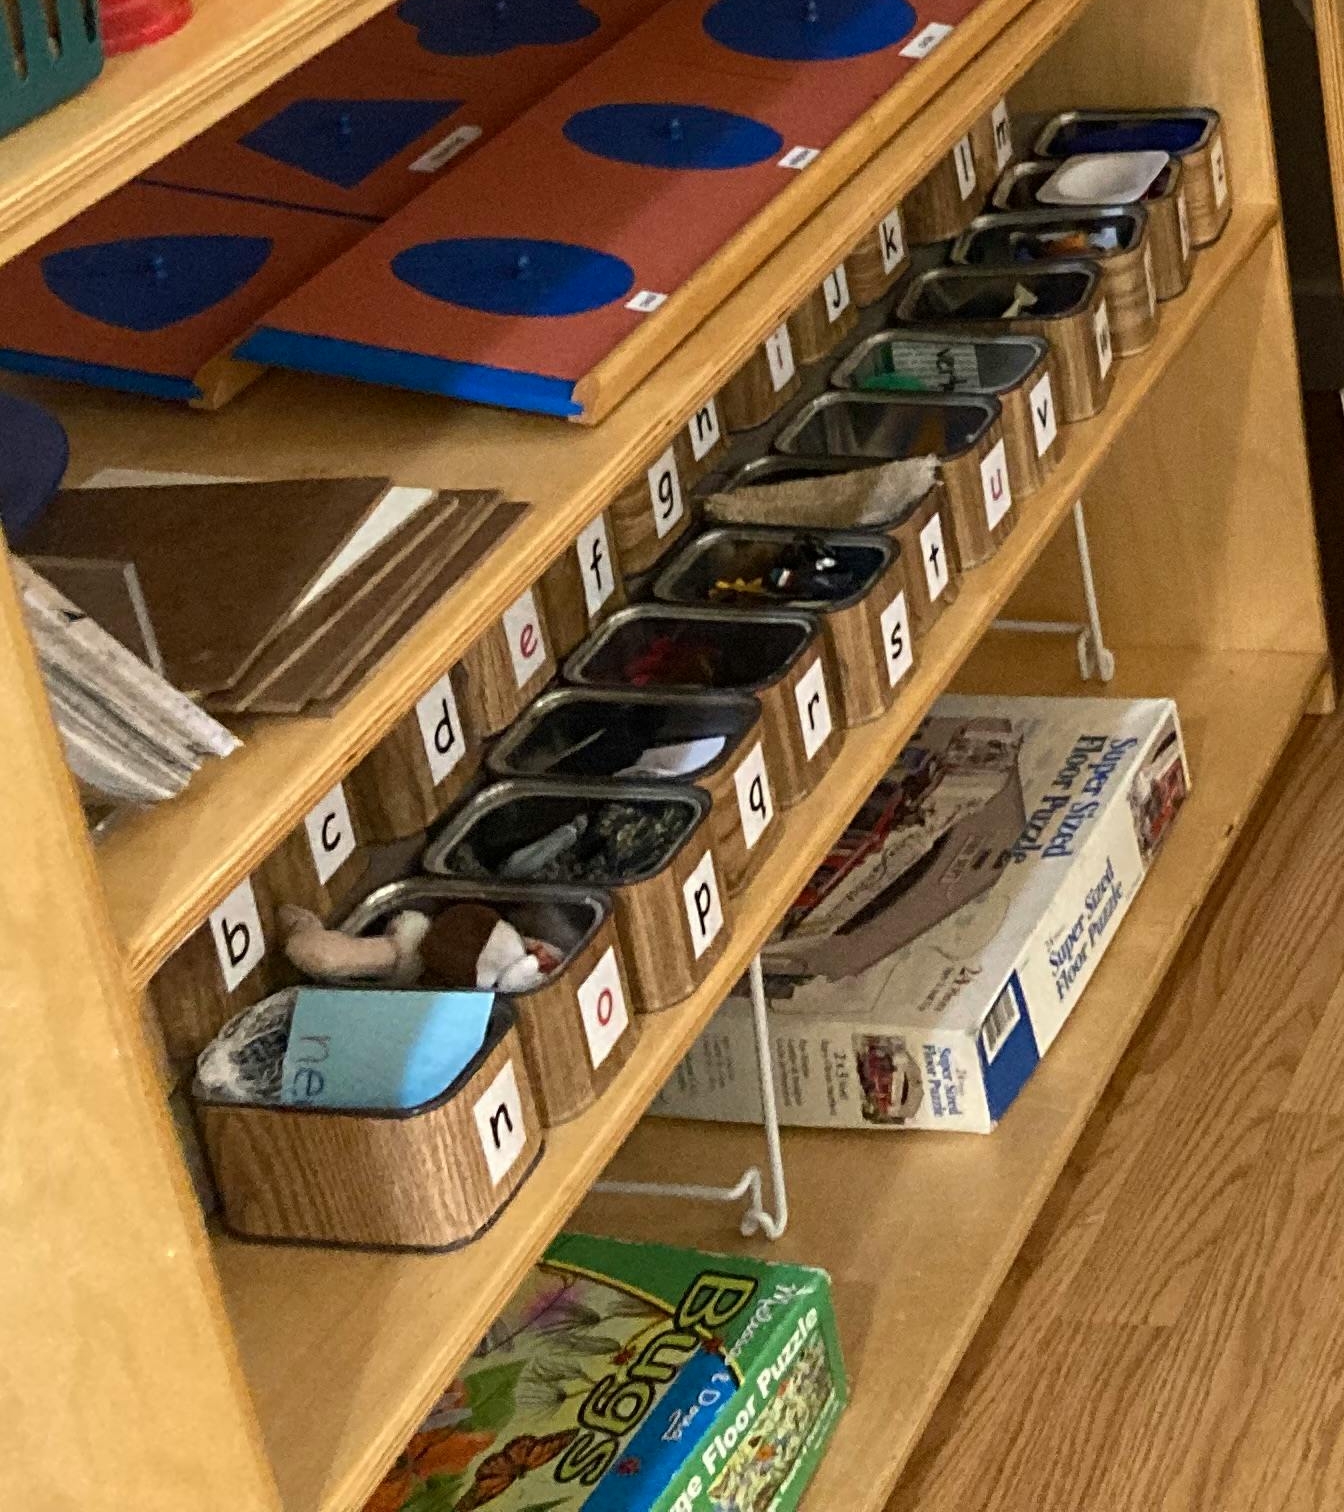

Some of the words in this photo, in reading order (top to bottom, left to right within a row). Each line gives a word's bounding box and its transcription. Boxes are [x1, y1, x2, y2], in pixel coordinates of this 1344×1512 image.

[882, 222, 898, 260] k
[1036, 399, 1048, 429] v
[657, 470, 675, 520] g
[990, 468, 1003, 502] u
[589, 538, 603, 590] f
[927, 542, 941, 579] t
[519, 622, 539, 659] e
[890, 620, 904, 661] s
[433, 697, 456, 755] d
[806, 691, 820, 731] r
[1051, 735, 1110, 790] Floor
[1081, 736, 1139, 797] Super
[748, 774, 767, 821] q
[320, 811, 342, 853] c
[1010, 794, 1072, 865] Puzzle
[1039, 800, 1101, 861] Sized
[693, 881, 712, 937] p
[1048, 914, 1086, 977] Super
[1083, 855, 1116, 919] Sized
[221, 917, 251, 968] b
[1054, 940, 1089, 1002] Floor
[1086, 879, 1124, 948] Puzzle
[596, 987, 614, 1027] o
[488, 1101, 514, 1149] n
[553, 1269, 759, 1488] Bugs
[701, 1394, 757, 1476] Floor
[755, 1307, 819, 1399] Puzzle
